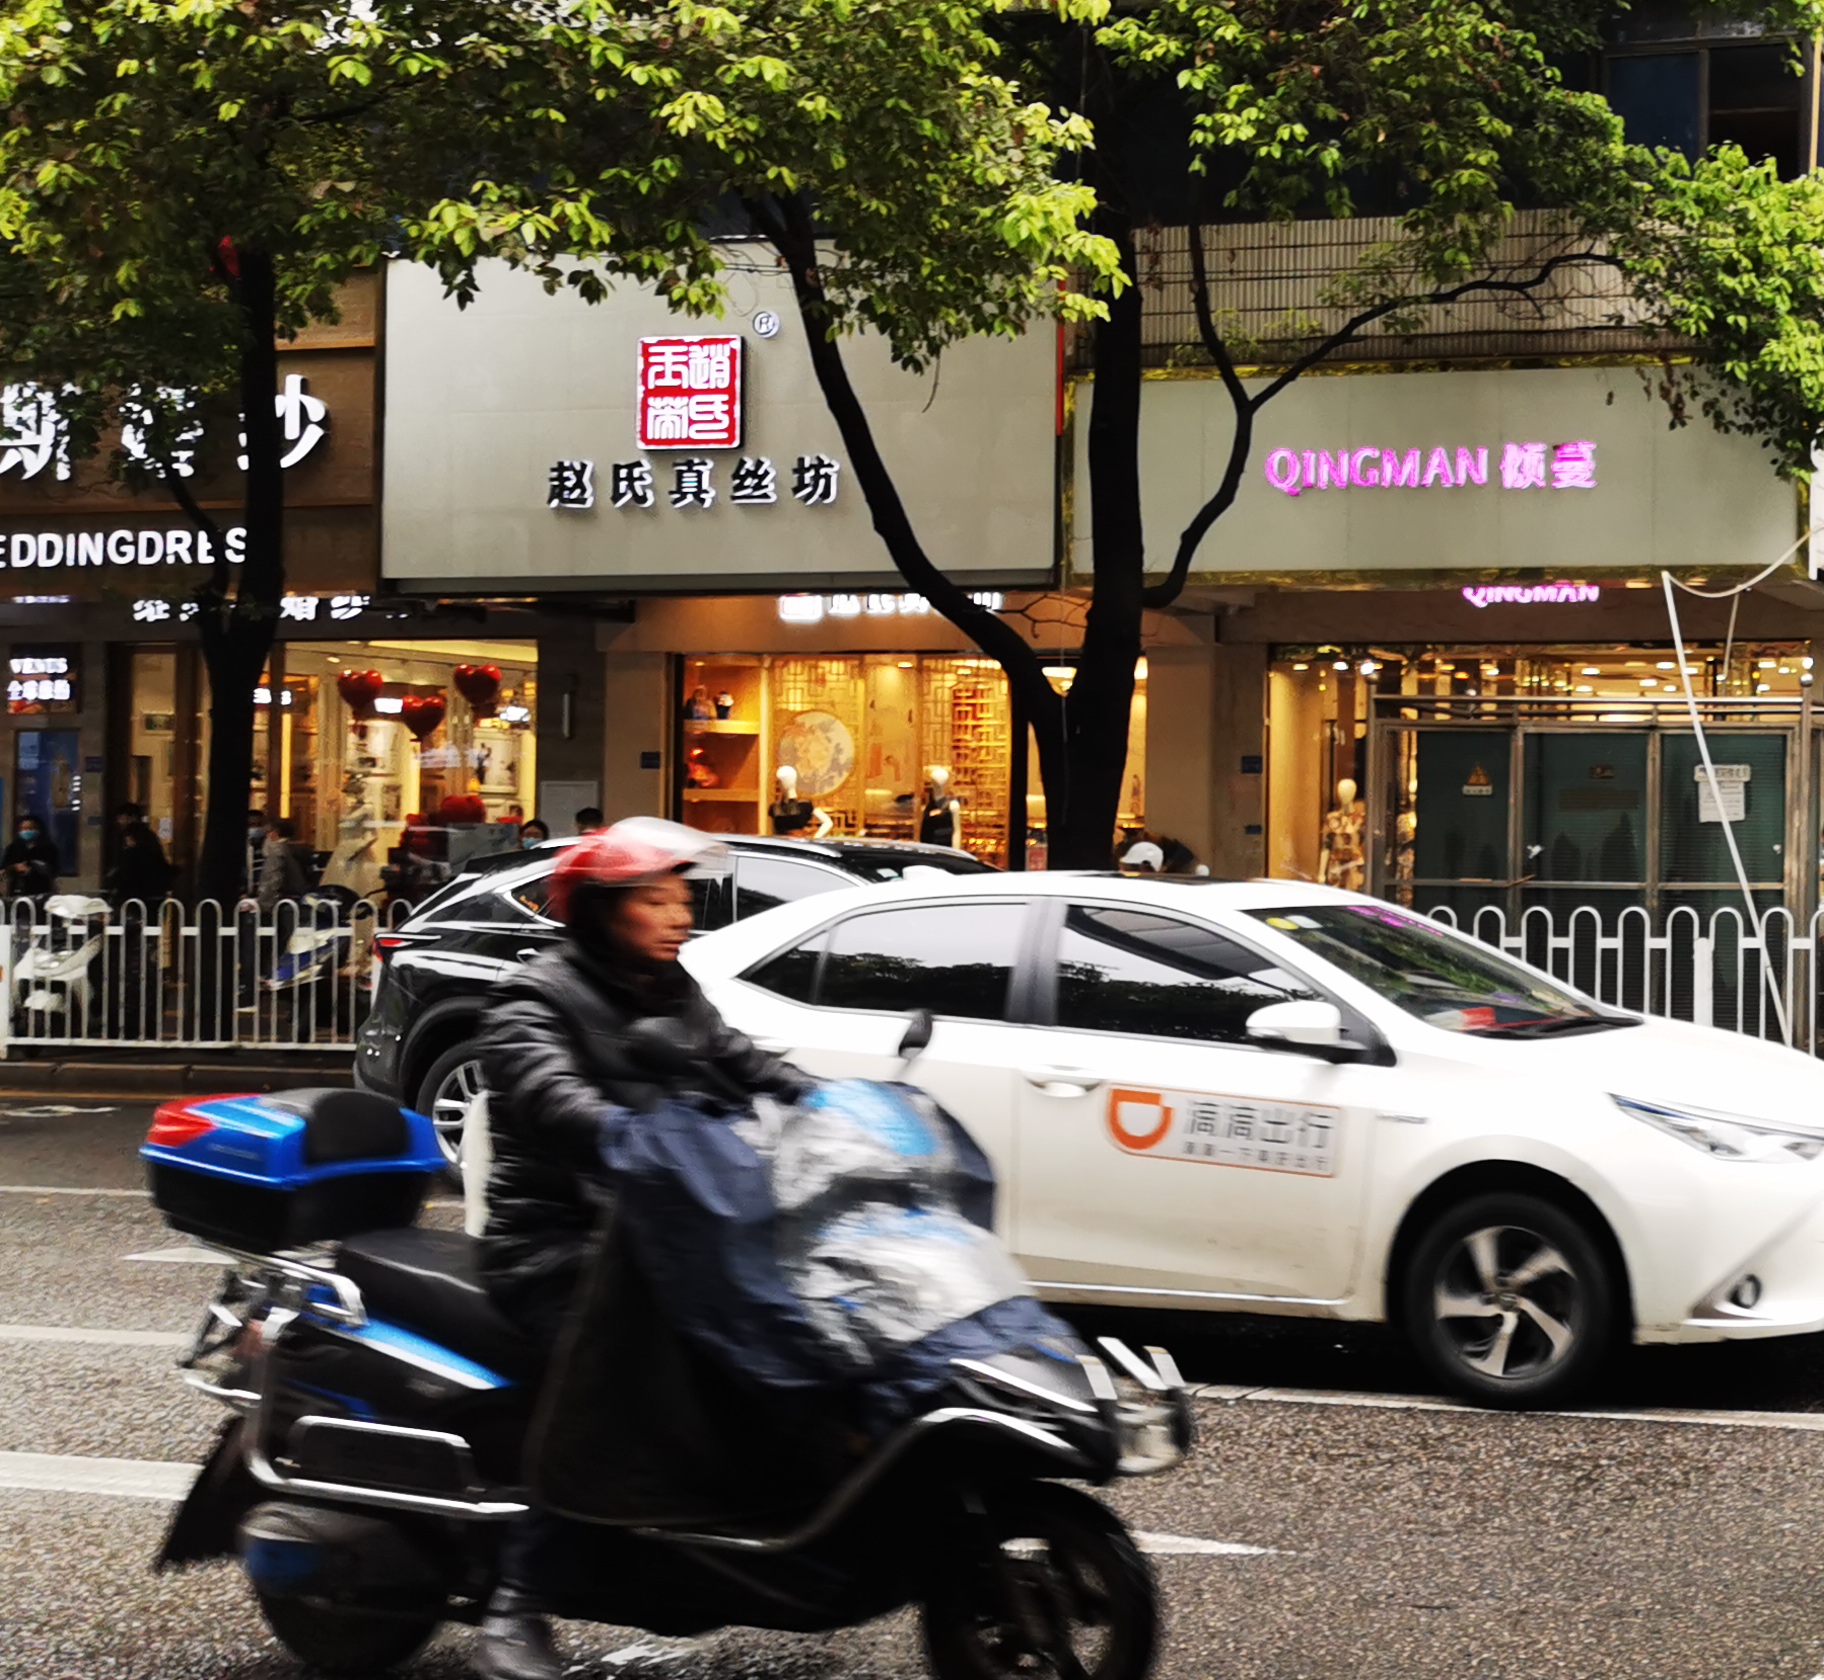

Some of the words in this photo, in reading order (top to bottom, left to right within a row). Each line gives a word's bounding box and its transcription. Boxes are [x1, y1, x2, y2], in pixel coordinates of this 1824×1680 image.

[547, 454, 841, 509] 赵氏真丝坊
[1264, 446, 1489, 497] QINGMAN
[1183, 1098, 1335, 1150] 滴滴出行
